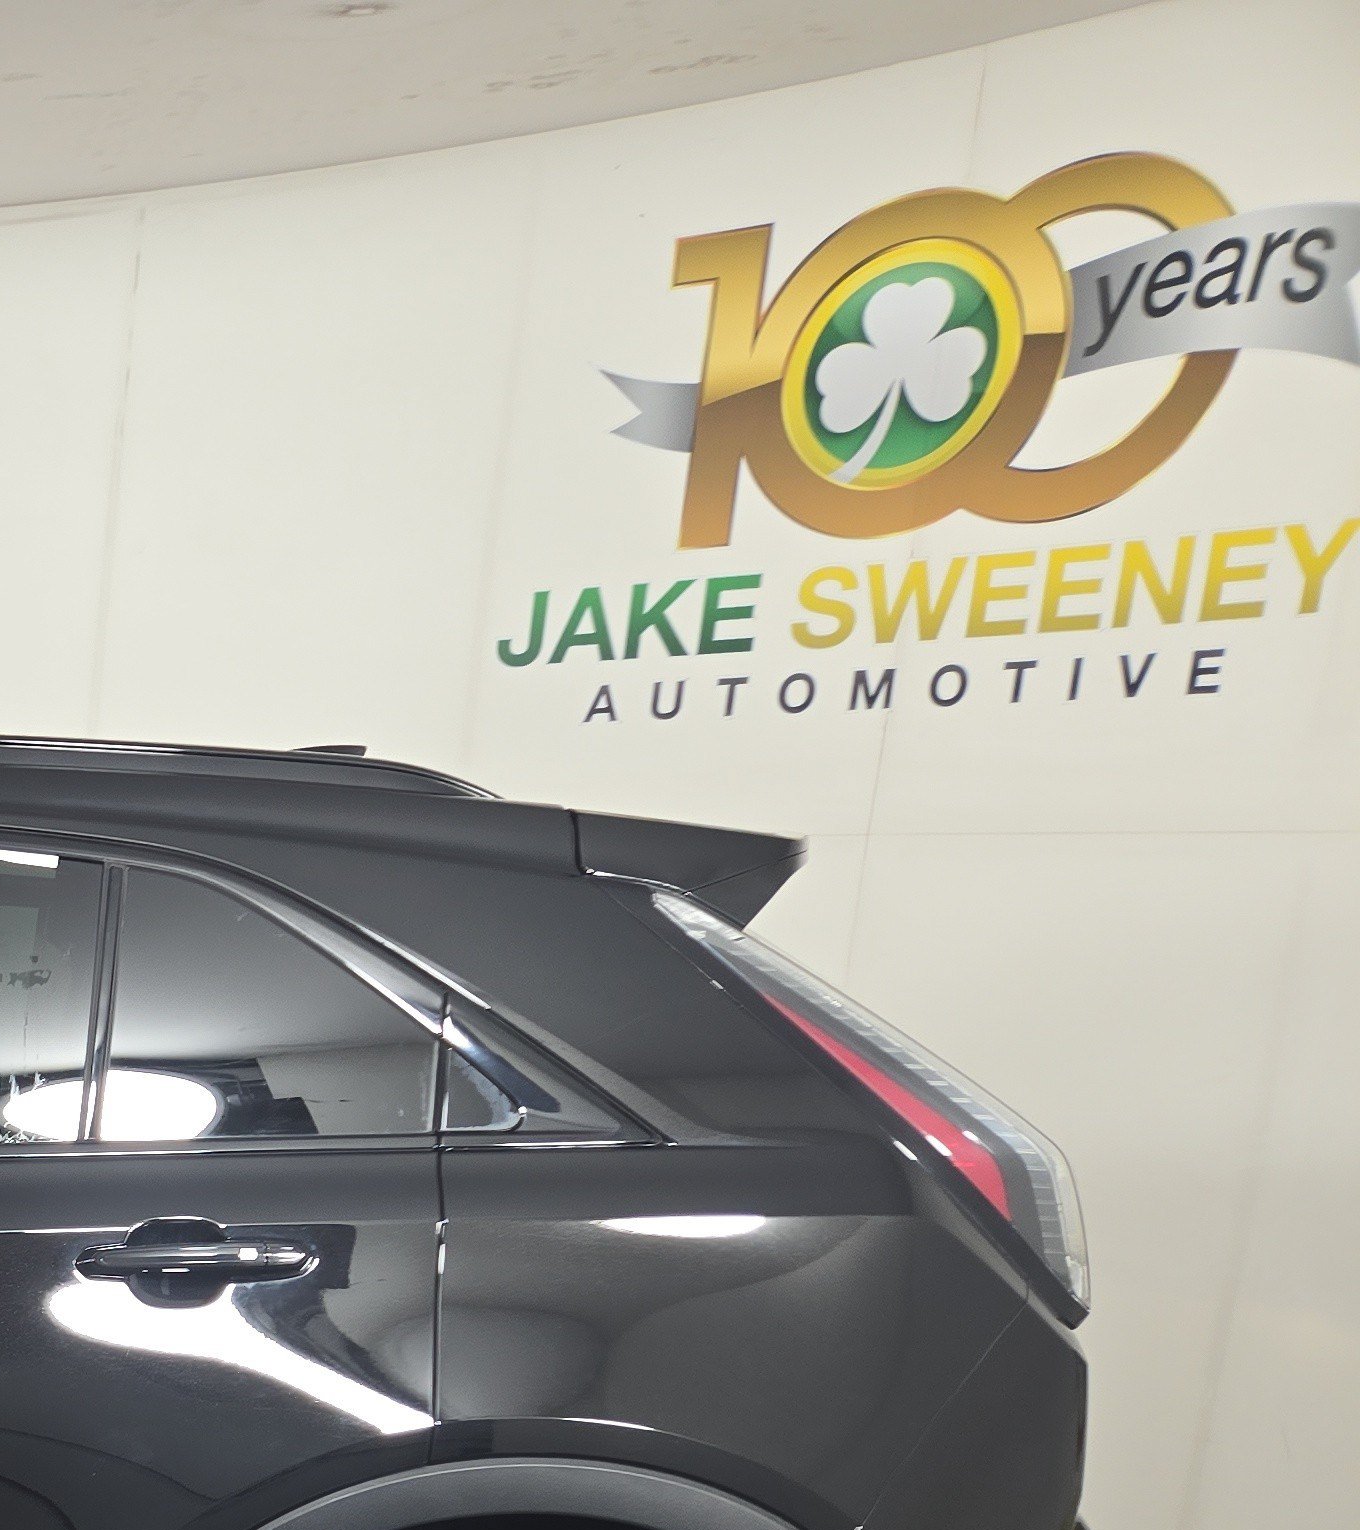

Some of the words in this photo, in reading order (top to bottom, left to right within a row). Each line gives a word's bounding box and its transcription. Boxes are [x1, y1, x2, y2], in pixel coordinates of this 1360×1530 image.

[671, 150, 1238, 549] 100
[1083, 224, 1336, 359] years
[496, 573, 763, 668] JAKE
[789, 516, 1360, 650] SWEENEY
[583, 648, 1227, 724] AUTOMOTIVE
